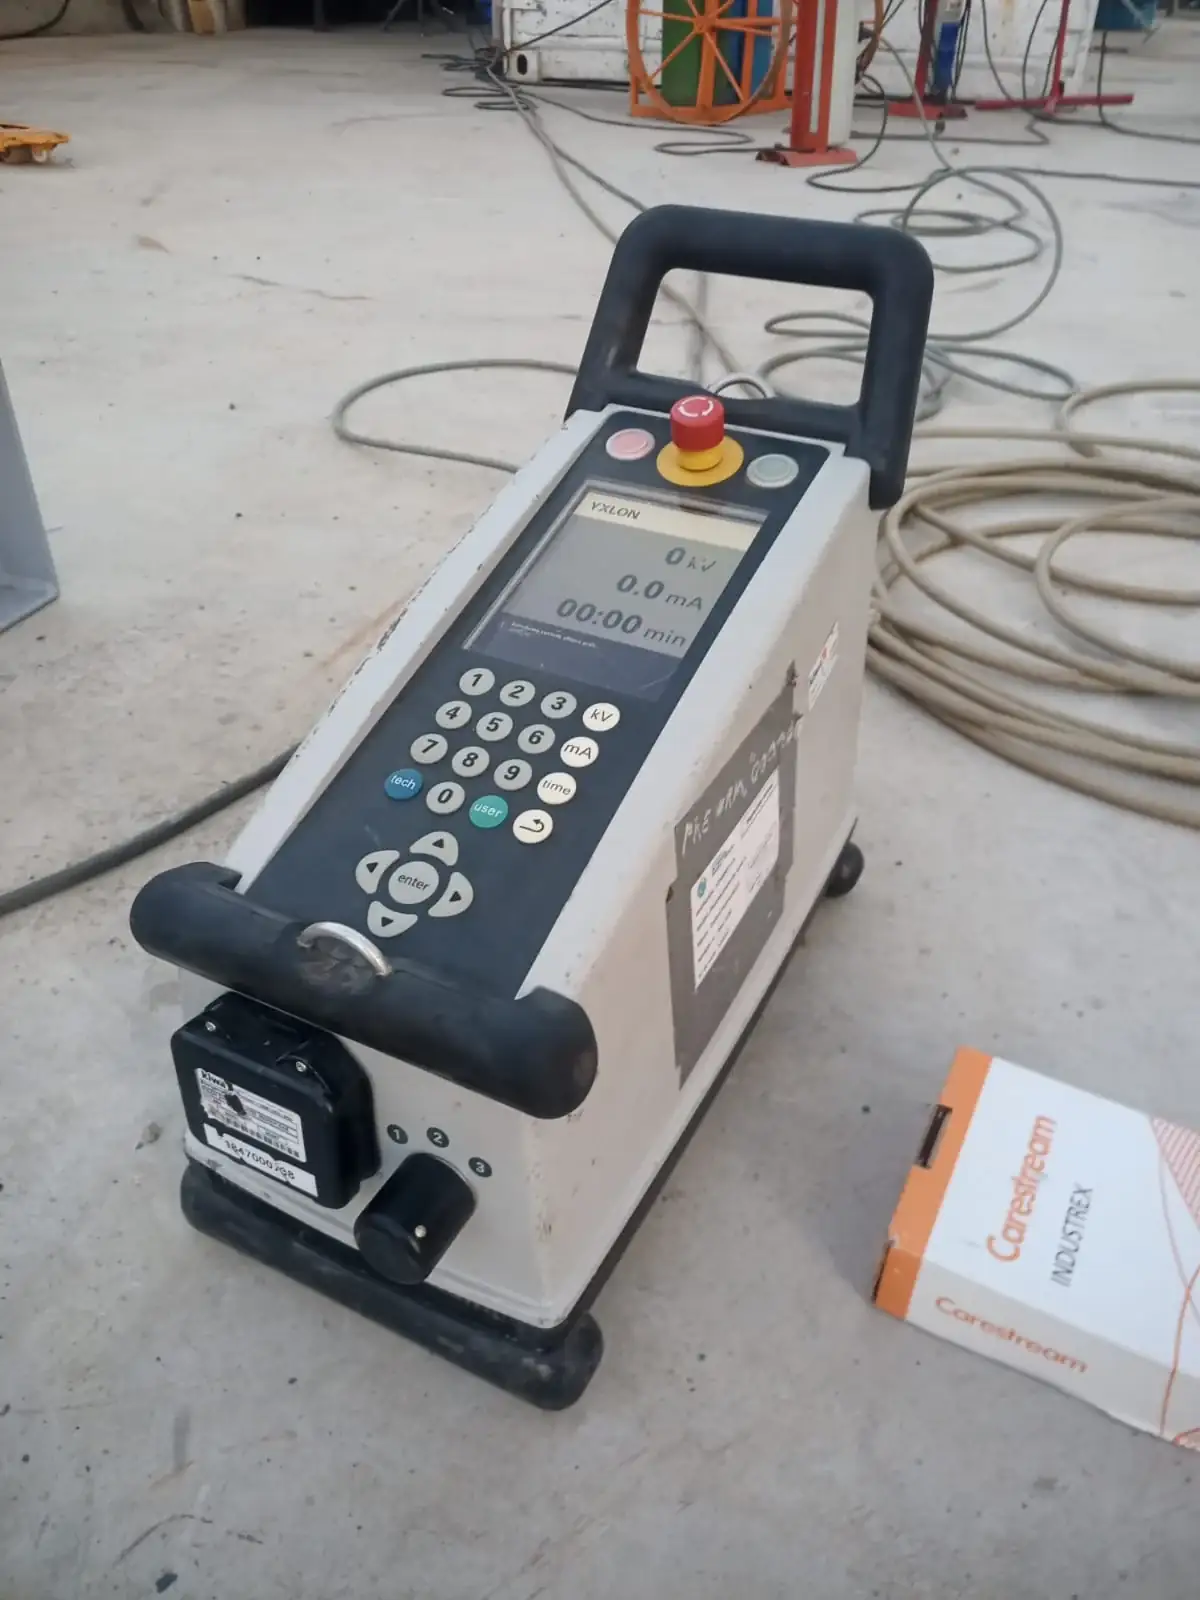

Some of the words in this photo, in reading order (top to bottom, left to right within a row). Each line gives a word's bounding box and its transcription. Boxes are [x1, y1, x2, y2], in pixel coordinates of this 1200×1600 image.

[590, 501, 641, 520] YXLON
[665, 547, 686, 565] 0
[616, 574, 665, 599] 0.0
[665, 594, 703, 610] mA
[557, 598, 643, 634] 00:00
[643, 628, 687, 648] min
[472, 673, 483, 687] 1
[508, 685, 525, 699] 2
[551, 697, 566, 711] 3
[445, 706, 461, 719] 4
[590, 708, 614, 722] kV
[486, 717, 503, 732] 5
[528, 730, 544, 745] 6
[421, 739, 439, 753] 7
[563, 743, 593, 759] mA
[462, 752, 479, 767] 8
[503, 765, 521, 780] 9
[390, 774, 416, 790] tech
[542, 779, 571, 796] time
[437, 788, 454, 804] 0
[473, 803, 502, 818] user
[397, 874, 431, 892] enter
[393, 1129, 401, 1140] 1
[433, 1132, 443, 1144] 2
[475, 1161, 485, 1174] 3
[986, 1115, 1058, 1263] Carestream
[1051, 1182, 1093, 1288] INDUSTREX
[935, 1296, 1089, 1374] Carestream
